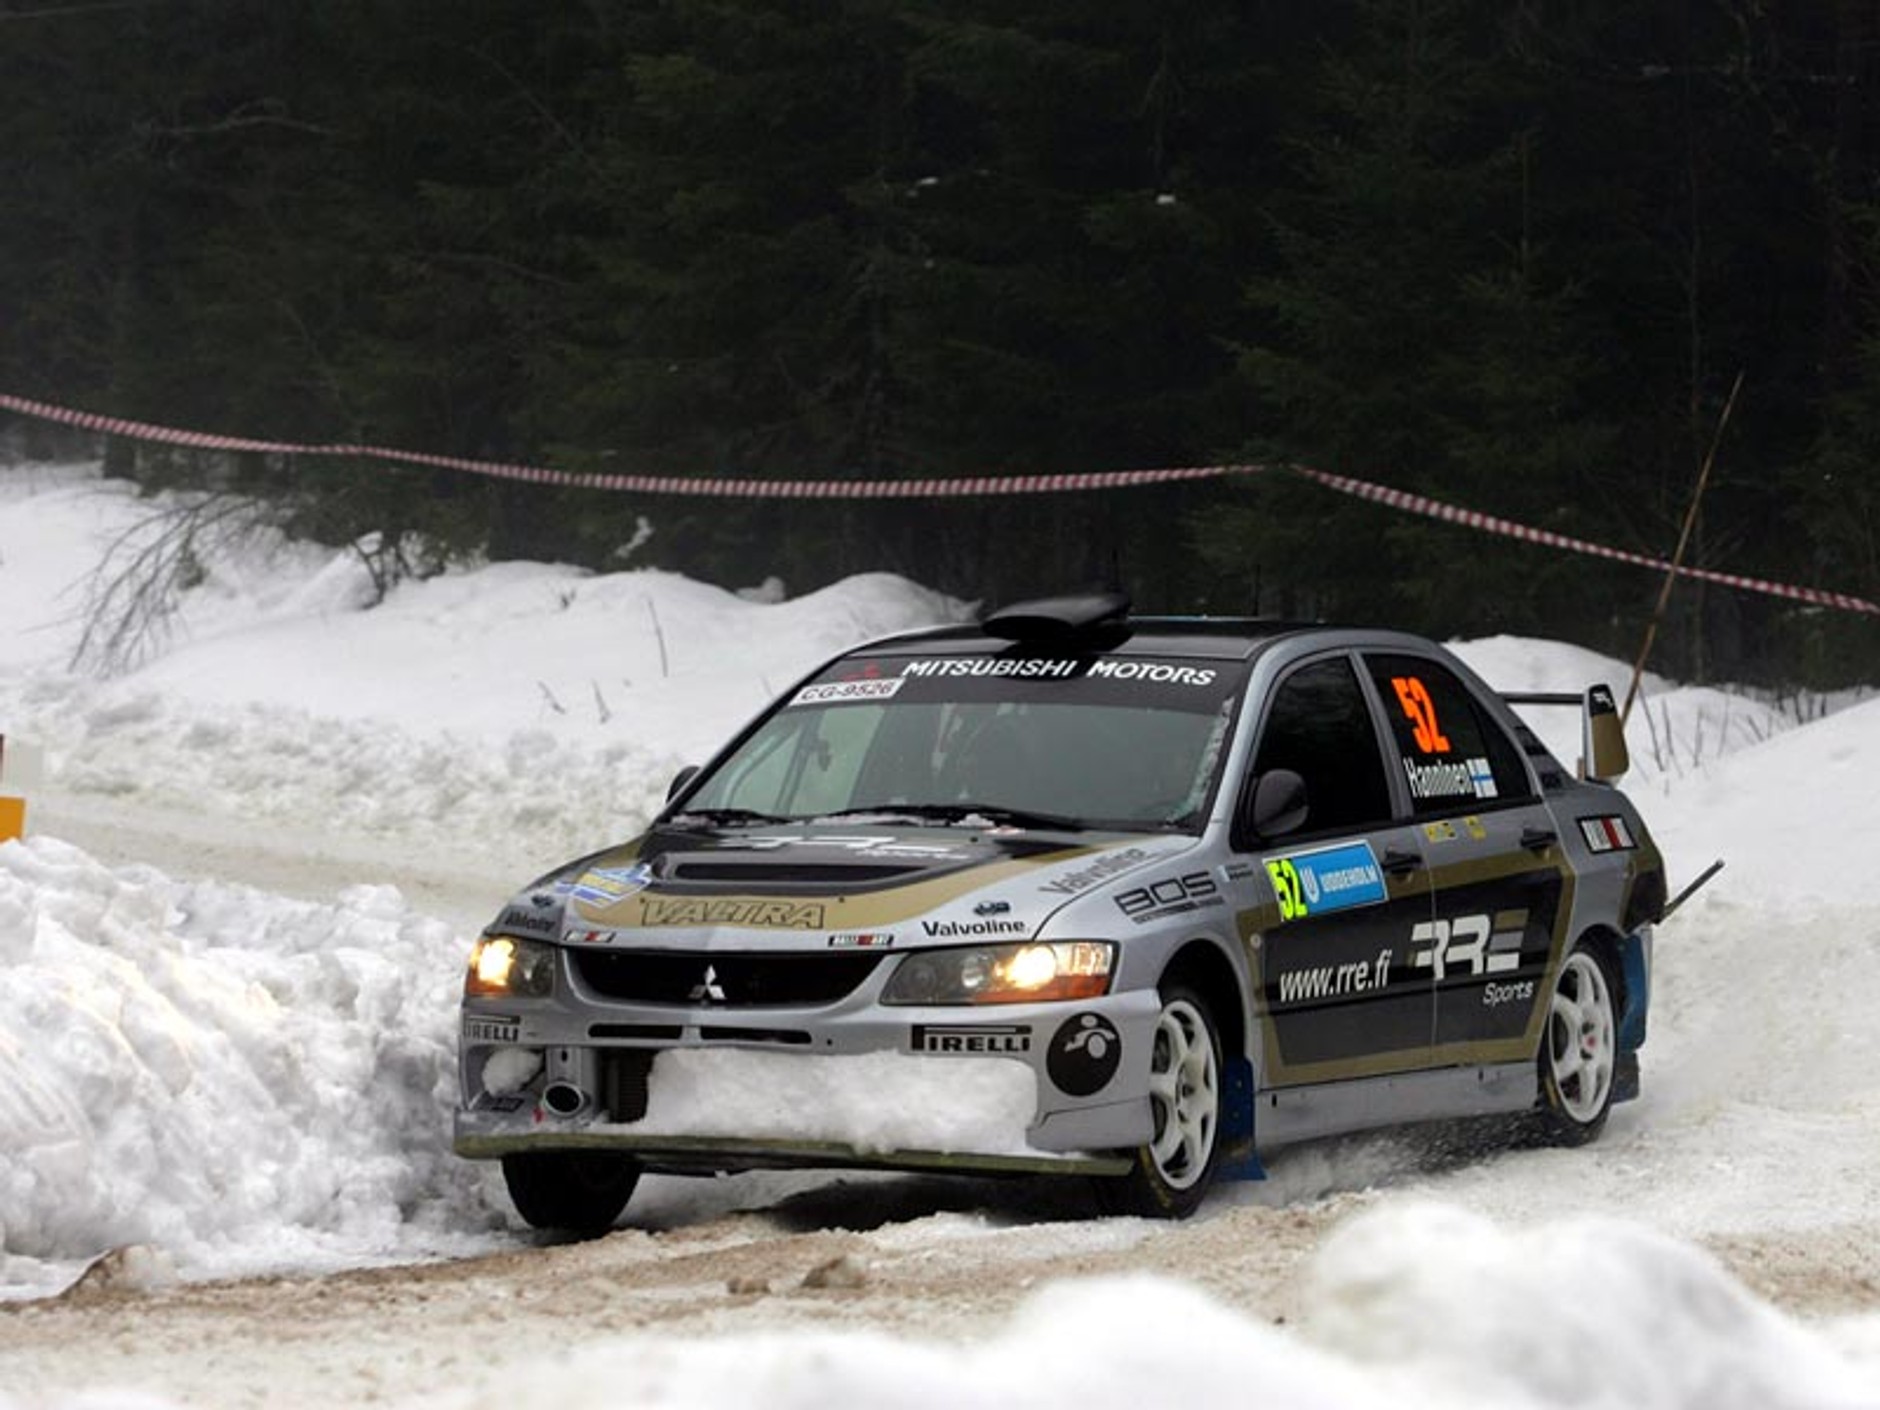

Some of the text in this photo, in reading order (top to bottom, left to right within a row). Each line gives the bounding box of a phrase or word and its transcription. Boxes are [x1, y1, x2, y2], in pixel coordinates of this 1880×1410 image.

[902, 659, 1217, 686] MITSUBISHI MOTORS
[801, 682, 896, 700] CG-9526
[1391, 676, 1452, 754] 52
[1113, 871, 1218, 916] BOS
[1266, 858, 1309, 920] 52
[642, 900, 825, 929] VALTRA
[921, 919, 1026, 937] Valvoline
[1408, 909, 1530, 982] RRE
[1279, 948, 1393, 1003] www.rre.fi
[1482, 980, 1535, 1007] Sports
[911, 1024, 1033, 1052] PIRELLI
